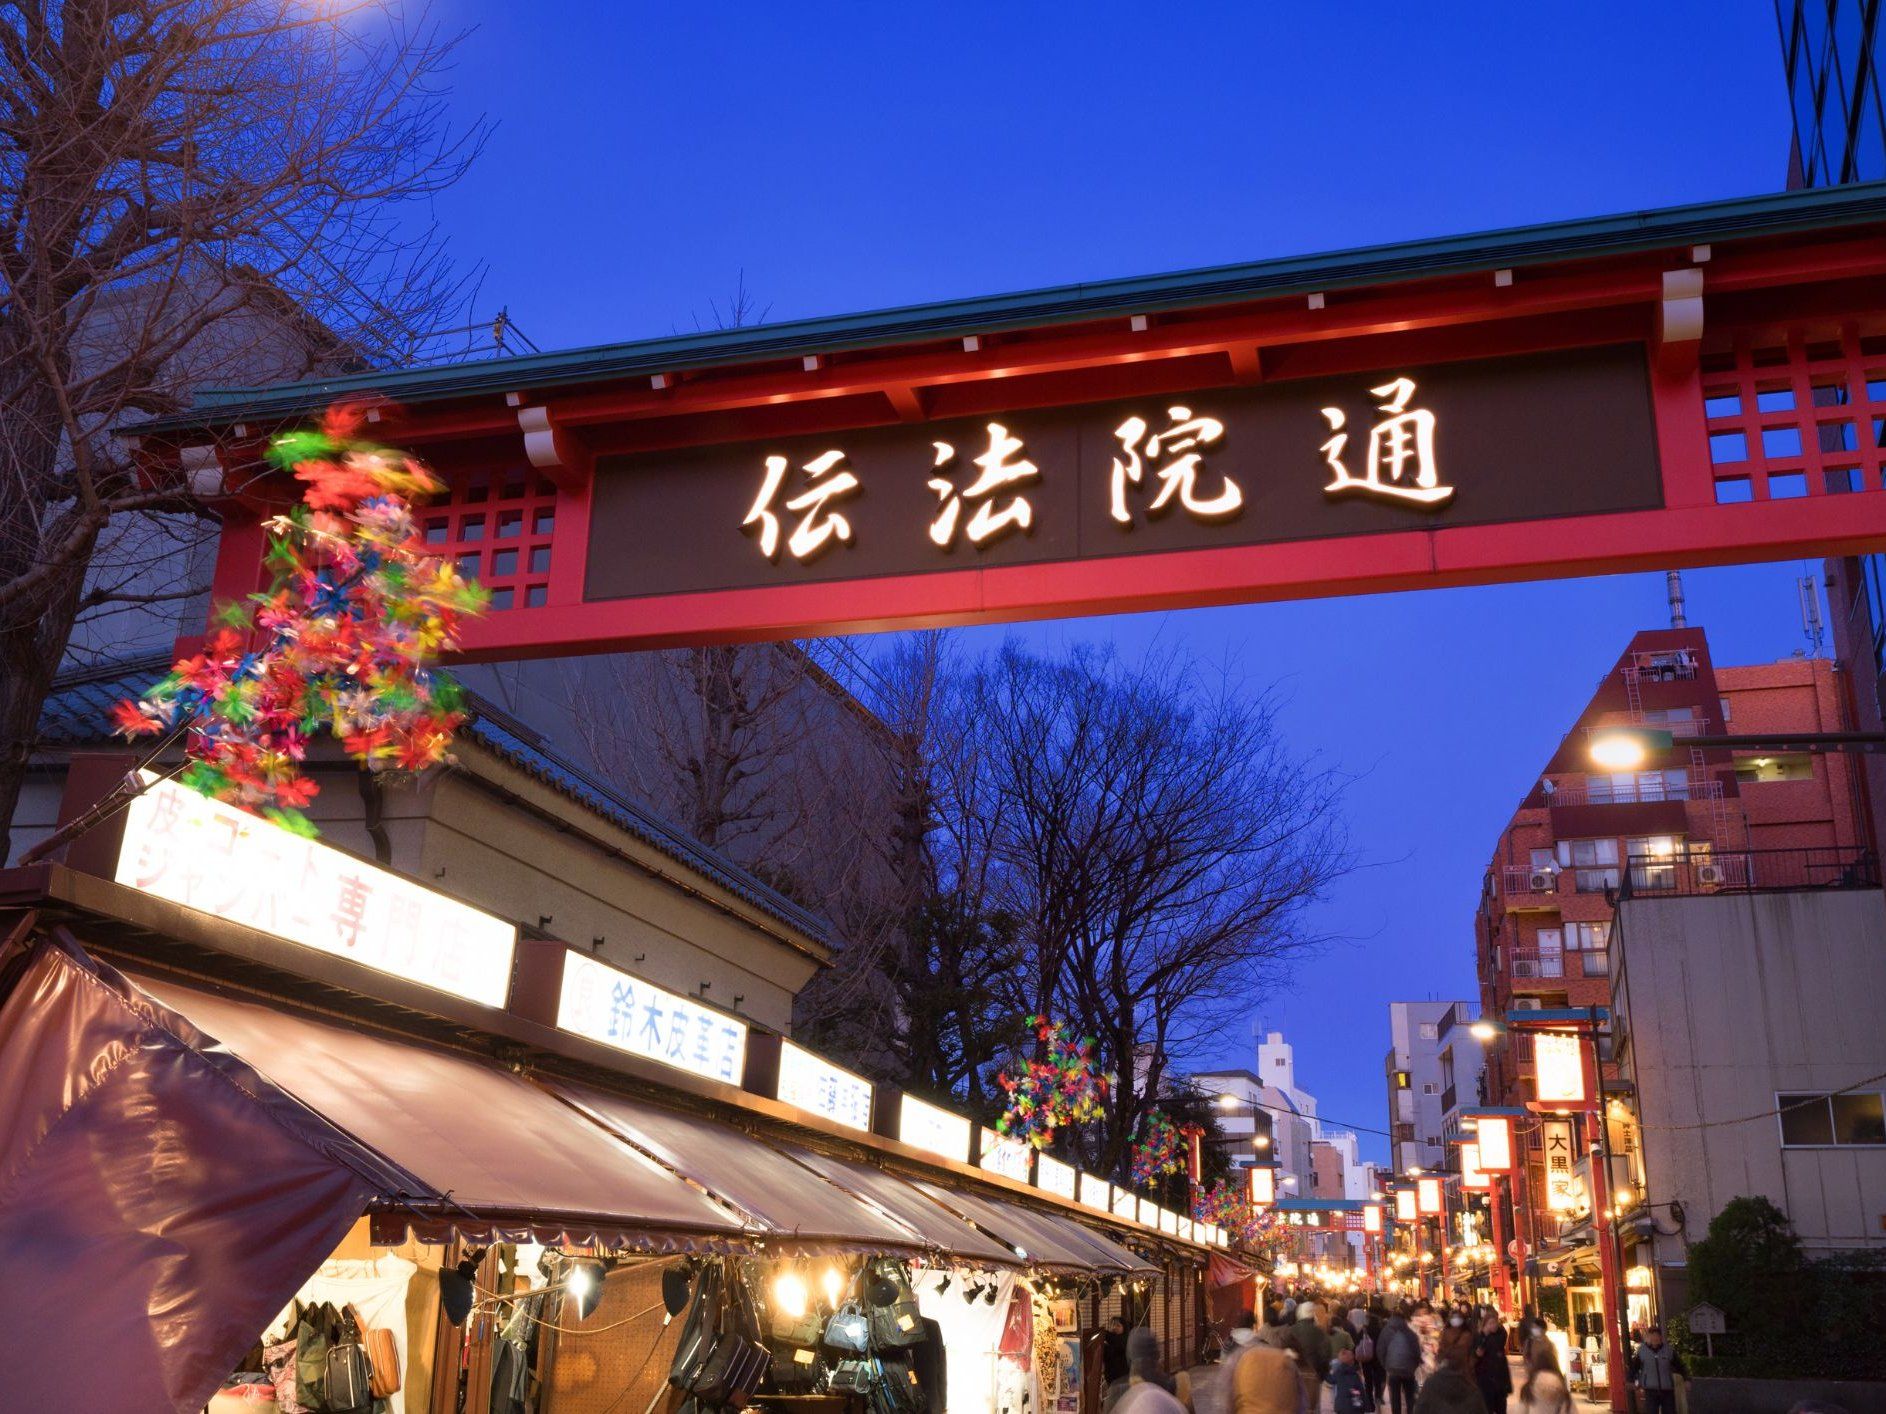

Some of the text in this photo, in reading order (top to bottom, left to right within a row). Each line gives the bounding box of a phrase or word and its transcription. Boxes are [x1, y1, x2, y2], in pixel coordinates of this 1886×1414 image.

[742, 377, 1455, 557] 伝法院通
[1548, 1133, 1569, 1196] 大黒家
